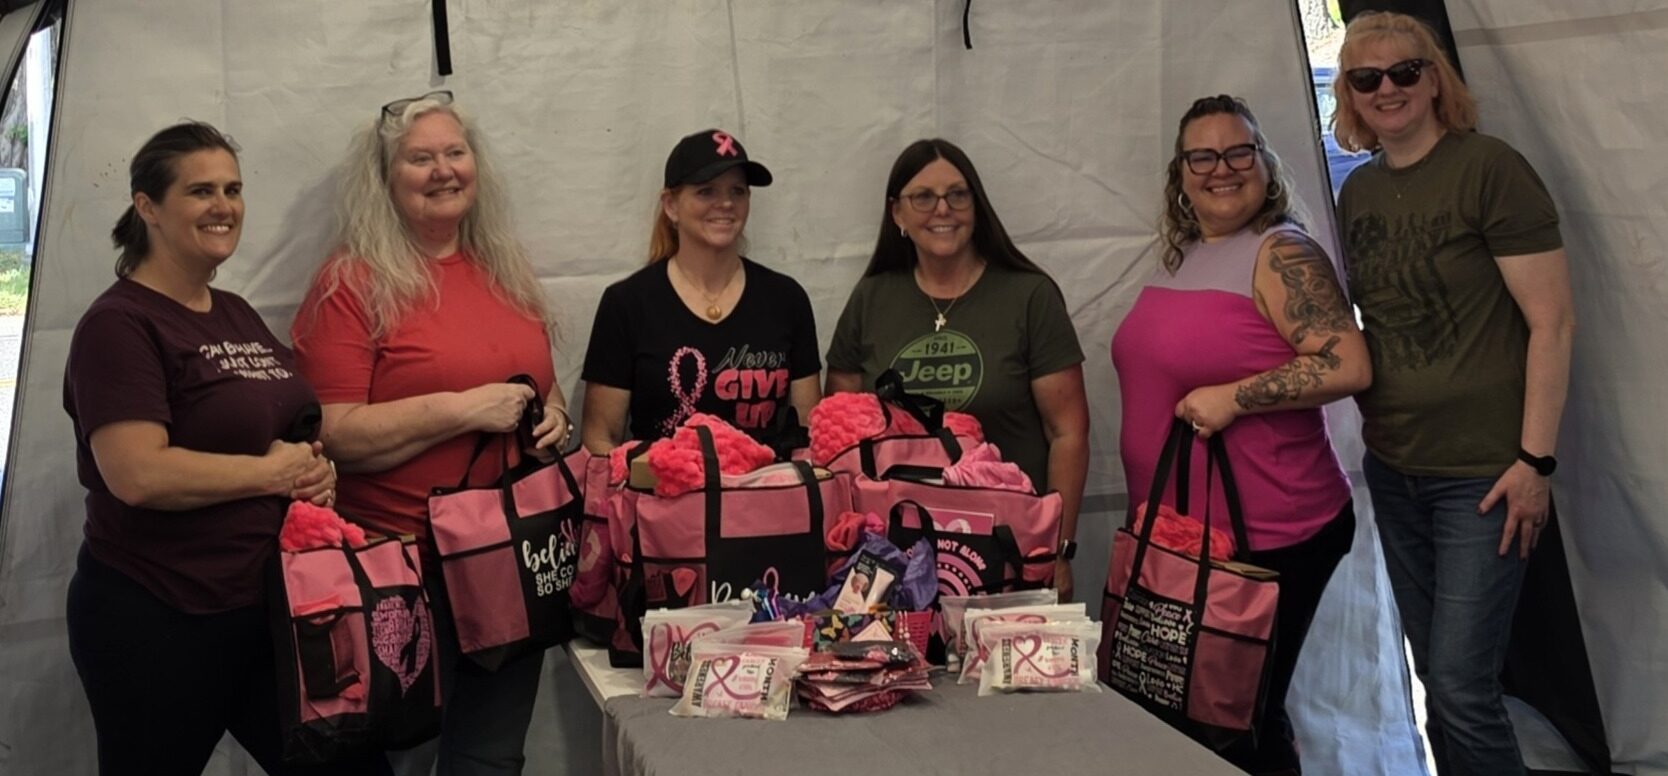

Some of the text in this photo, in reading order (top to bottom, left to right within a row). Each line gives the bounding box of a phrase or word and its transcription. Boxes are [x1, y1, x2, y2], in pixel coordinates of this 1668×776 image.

[925, 341, 955, 355] 1941
[711, 344, 786, 374] Never
[899, 360, 973, 385] Jeep
[714, 368, 789, 400] GIVE
[736, 401, 776, 428] UP
[937, 538, 959, 552] NOT
[535, 570, 558, 586] SHE
[536, 583, 554, 597] SO
[1151, 624, 1187, 645] HOPE
[1123, 644, 1147, 662] HOPE
